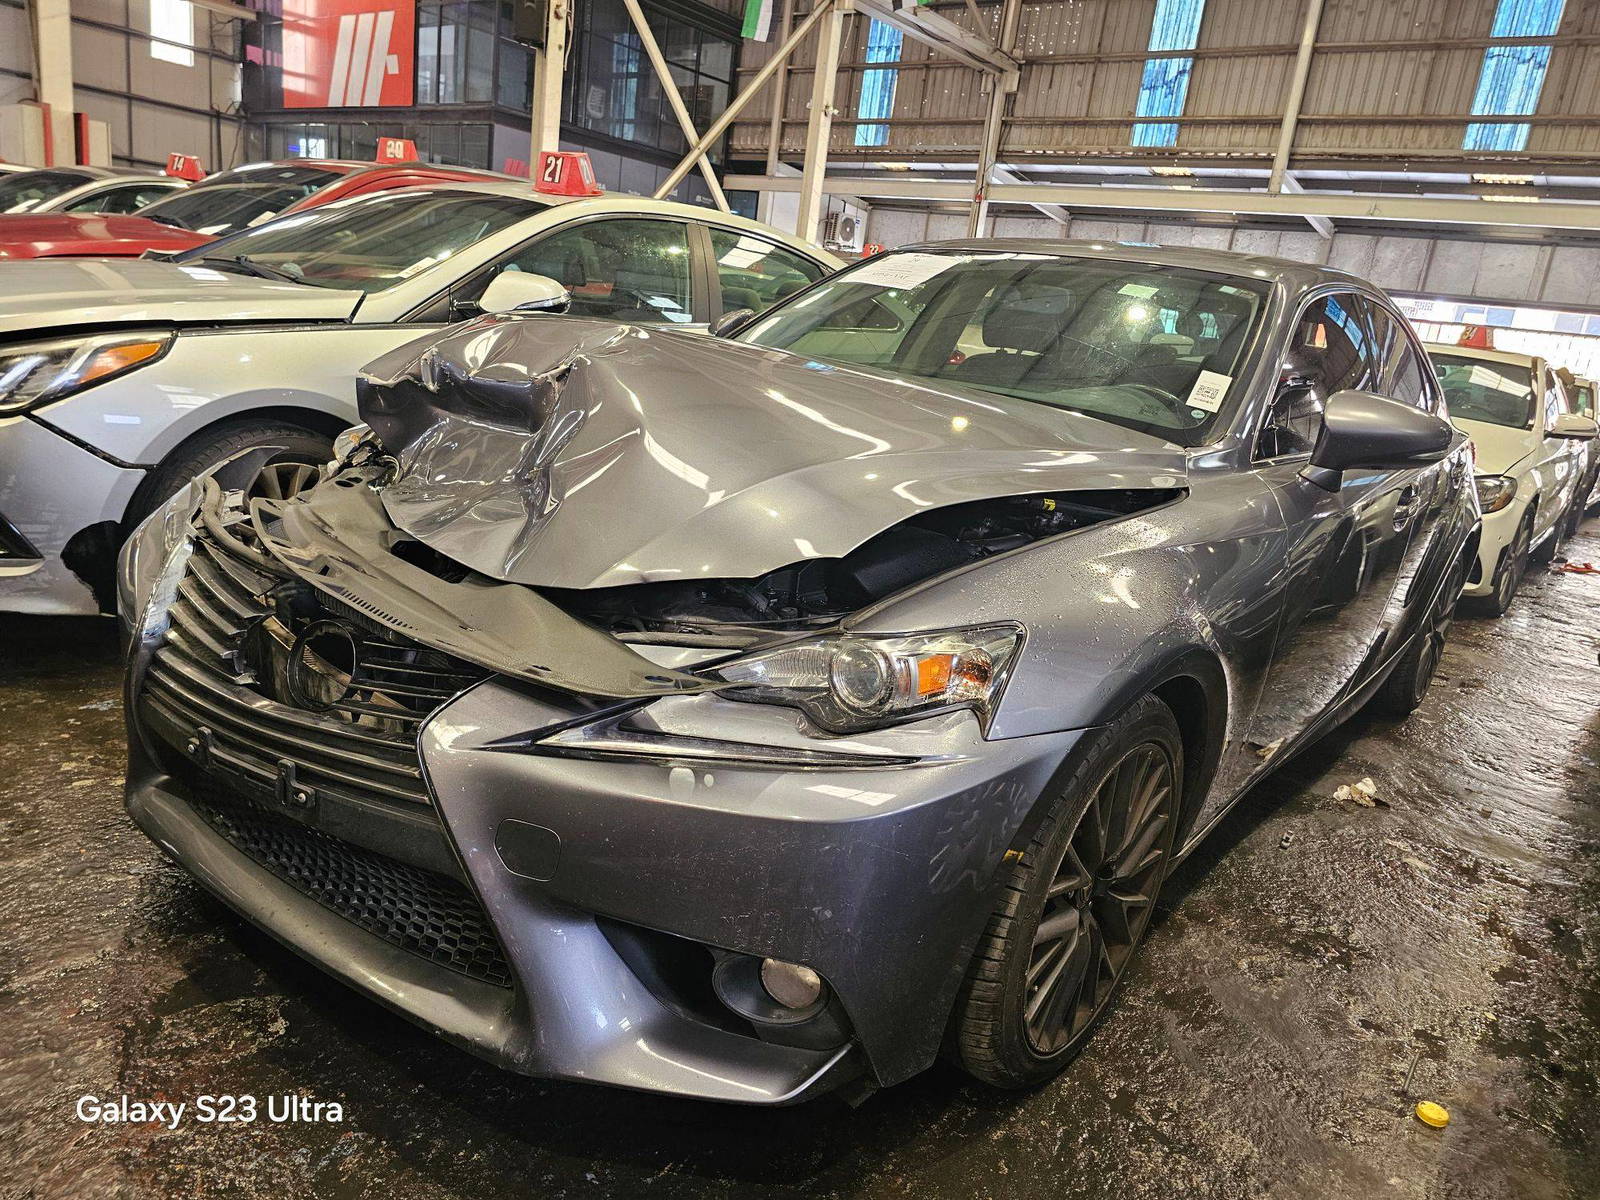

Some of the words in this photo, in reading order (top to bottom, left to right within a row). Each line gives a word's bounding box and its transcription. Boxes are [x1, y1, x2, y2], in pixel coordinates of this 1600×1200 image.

[172, 156, 185, 171] 14
[544, 156, 563, 183] 21
[869, 245, 879, 255] 22
